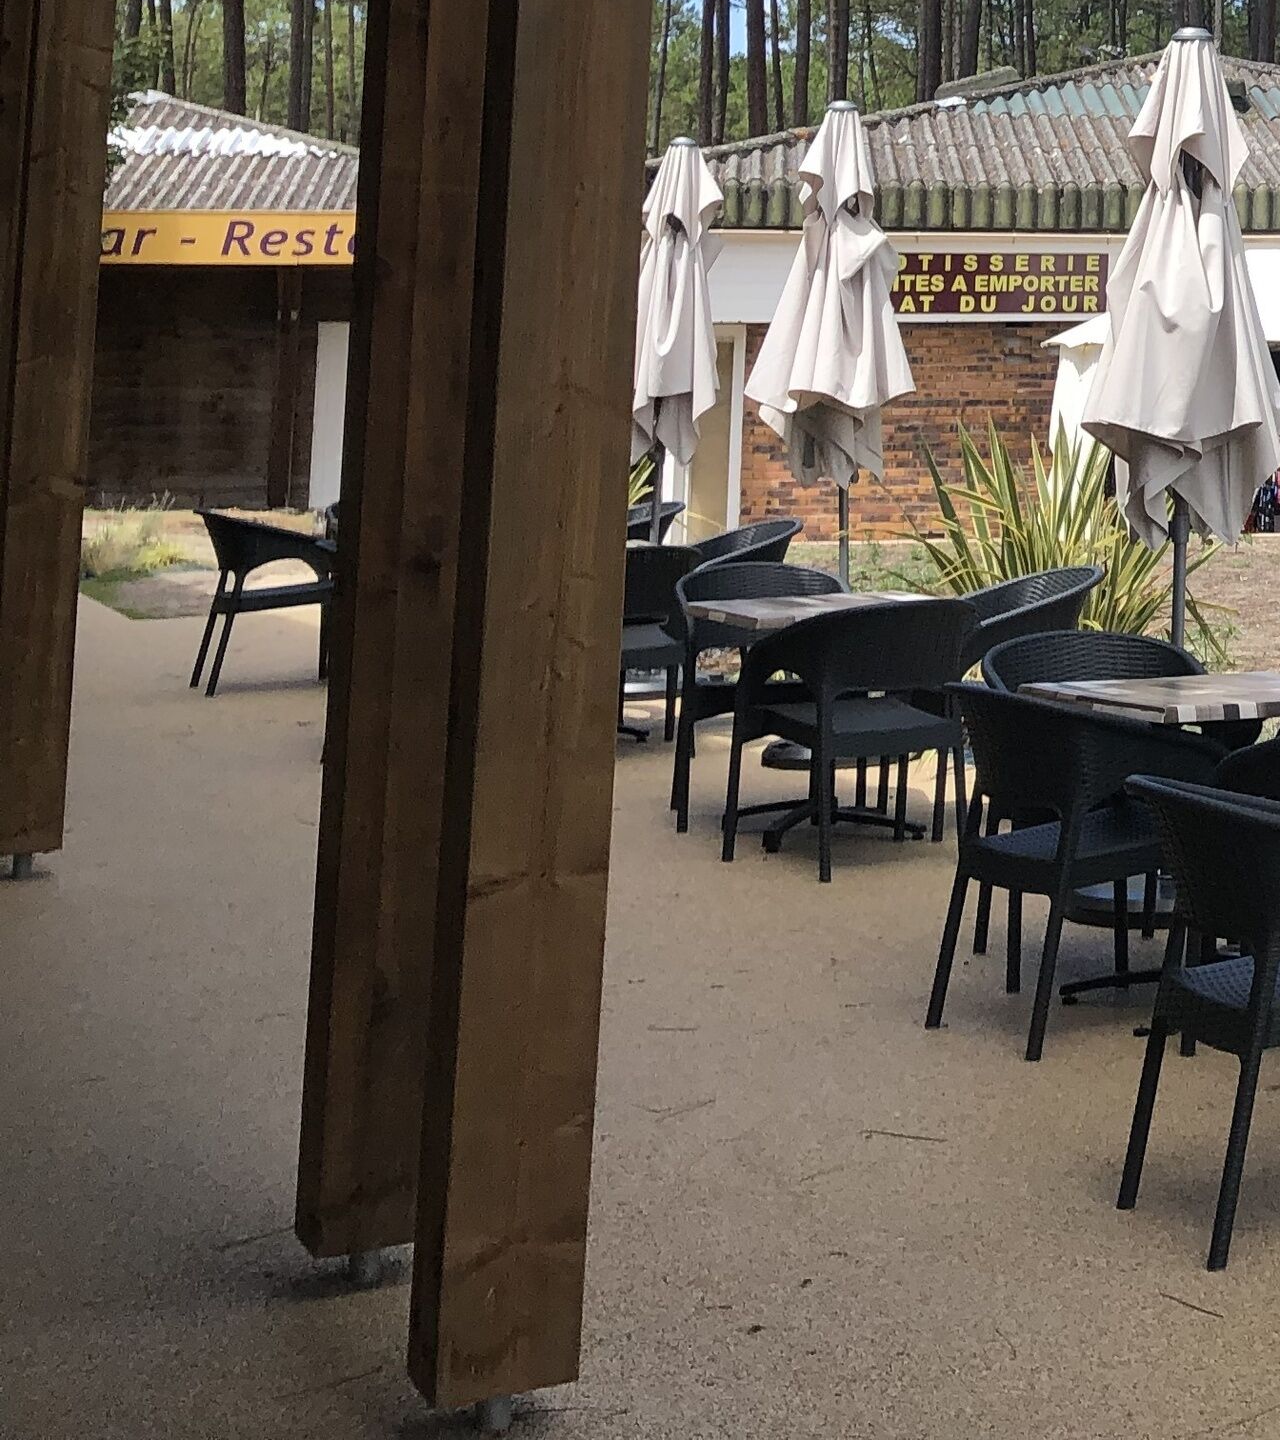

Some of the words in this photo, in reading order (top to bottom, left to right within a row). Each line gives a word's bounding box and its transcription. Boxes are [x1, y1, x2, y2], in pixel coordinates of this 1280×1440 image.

[951, 275, 967, 292] A
[975, 275, 1099, 292] EMPORTER
[960, 295, 997, 312] DU
[1021, 295, 1098, 312] JOUR
